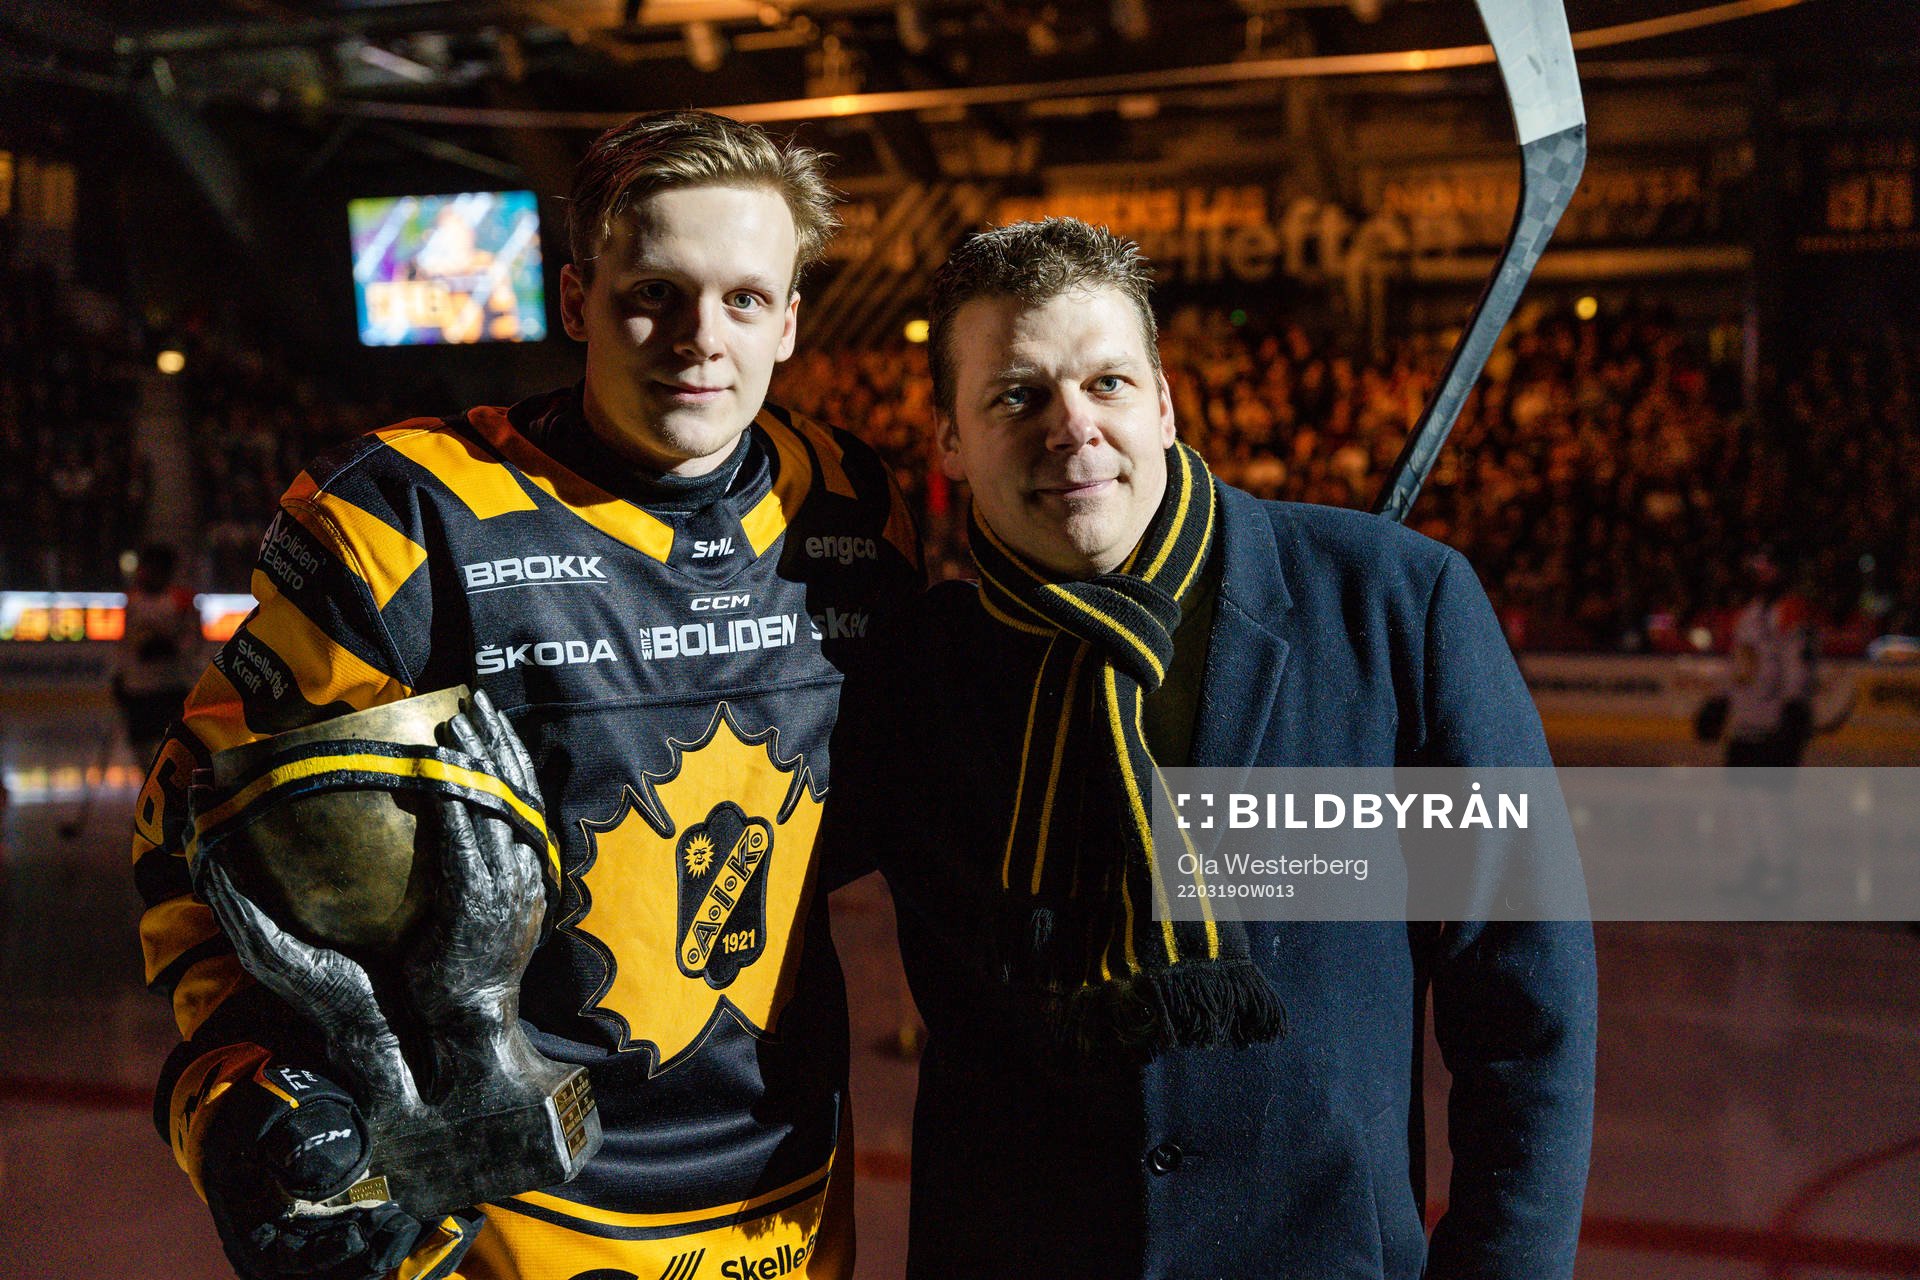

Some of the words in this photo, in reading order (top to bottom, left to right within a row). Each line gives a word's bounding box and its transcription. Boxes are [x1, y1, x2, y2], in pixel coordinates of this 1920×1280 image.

[692, 537, 735, 559] SHL
[805, 535, 878, 565] engco
[461, 555, 607, 588] BROKK
[690, 595, 750, 611] CCM
[651, 613, 798, 659] BOLIDEN
[475, 639, 618, 675] ŠKODA
[232, 655, 260, 694] Kraft
[722, 928, 756, 954] 1921
[721, 1234, 818, 1280] Skellef
